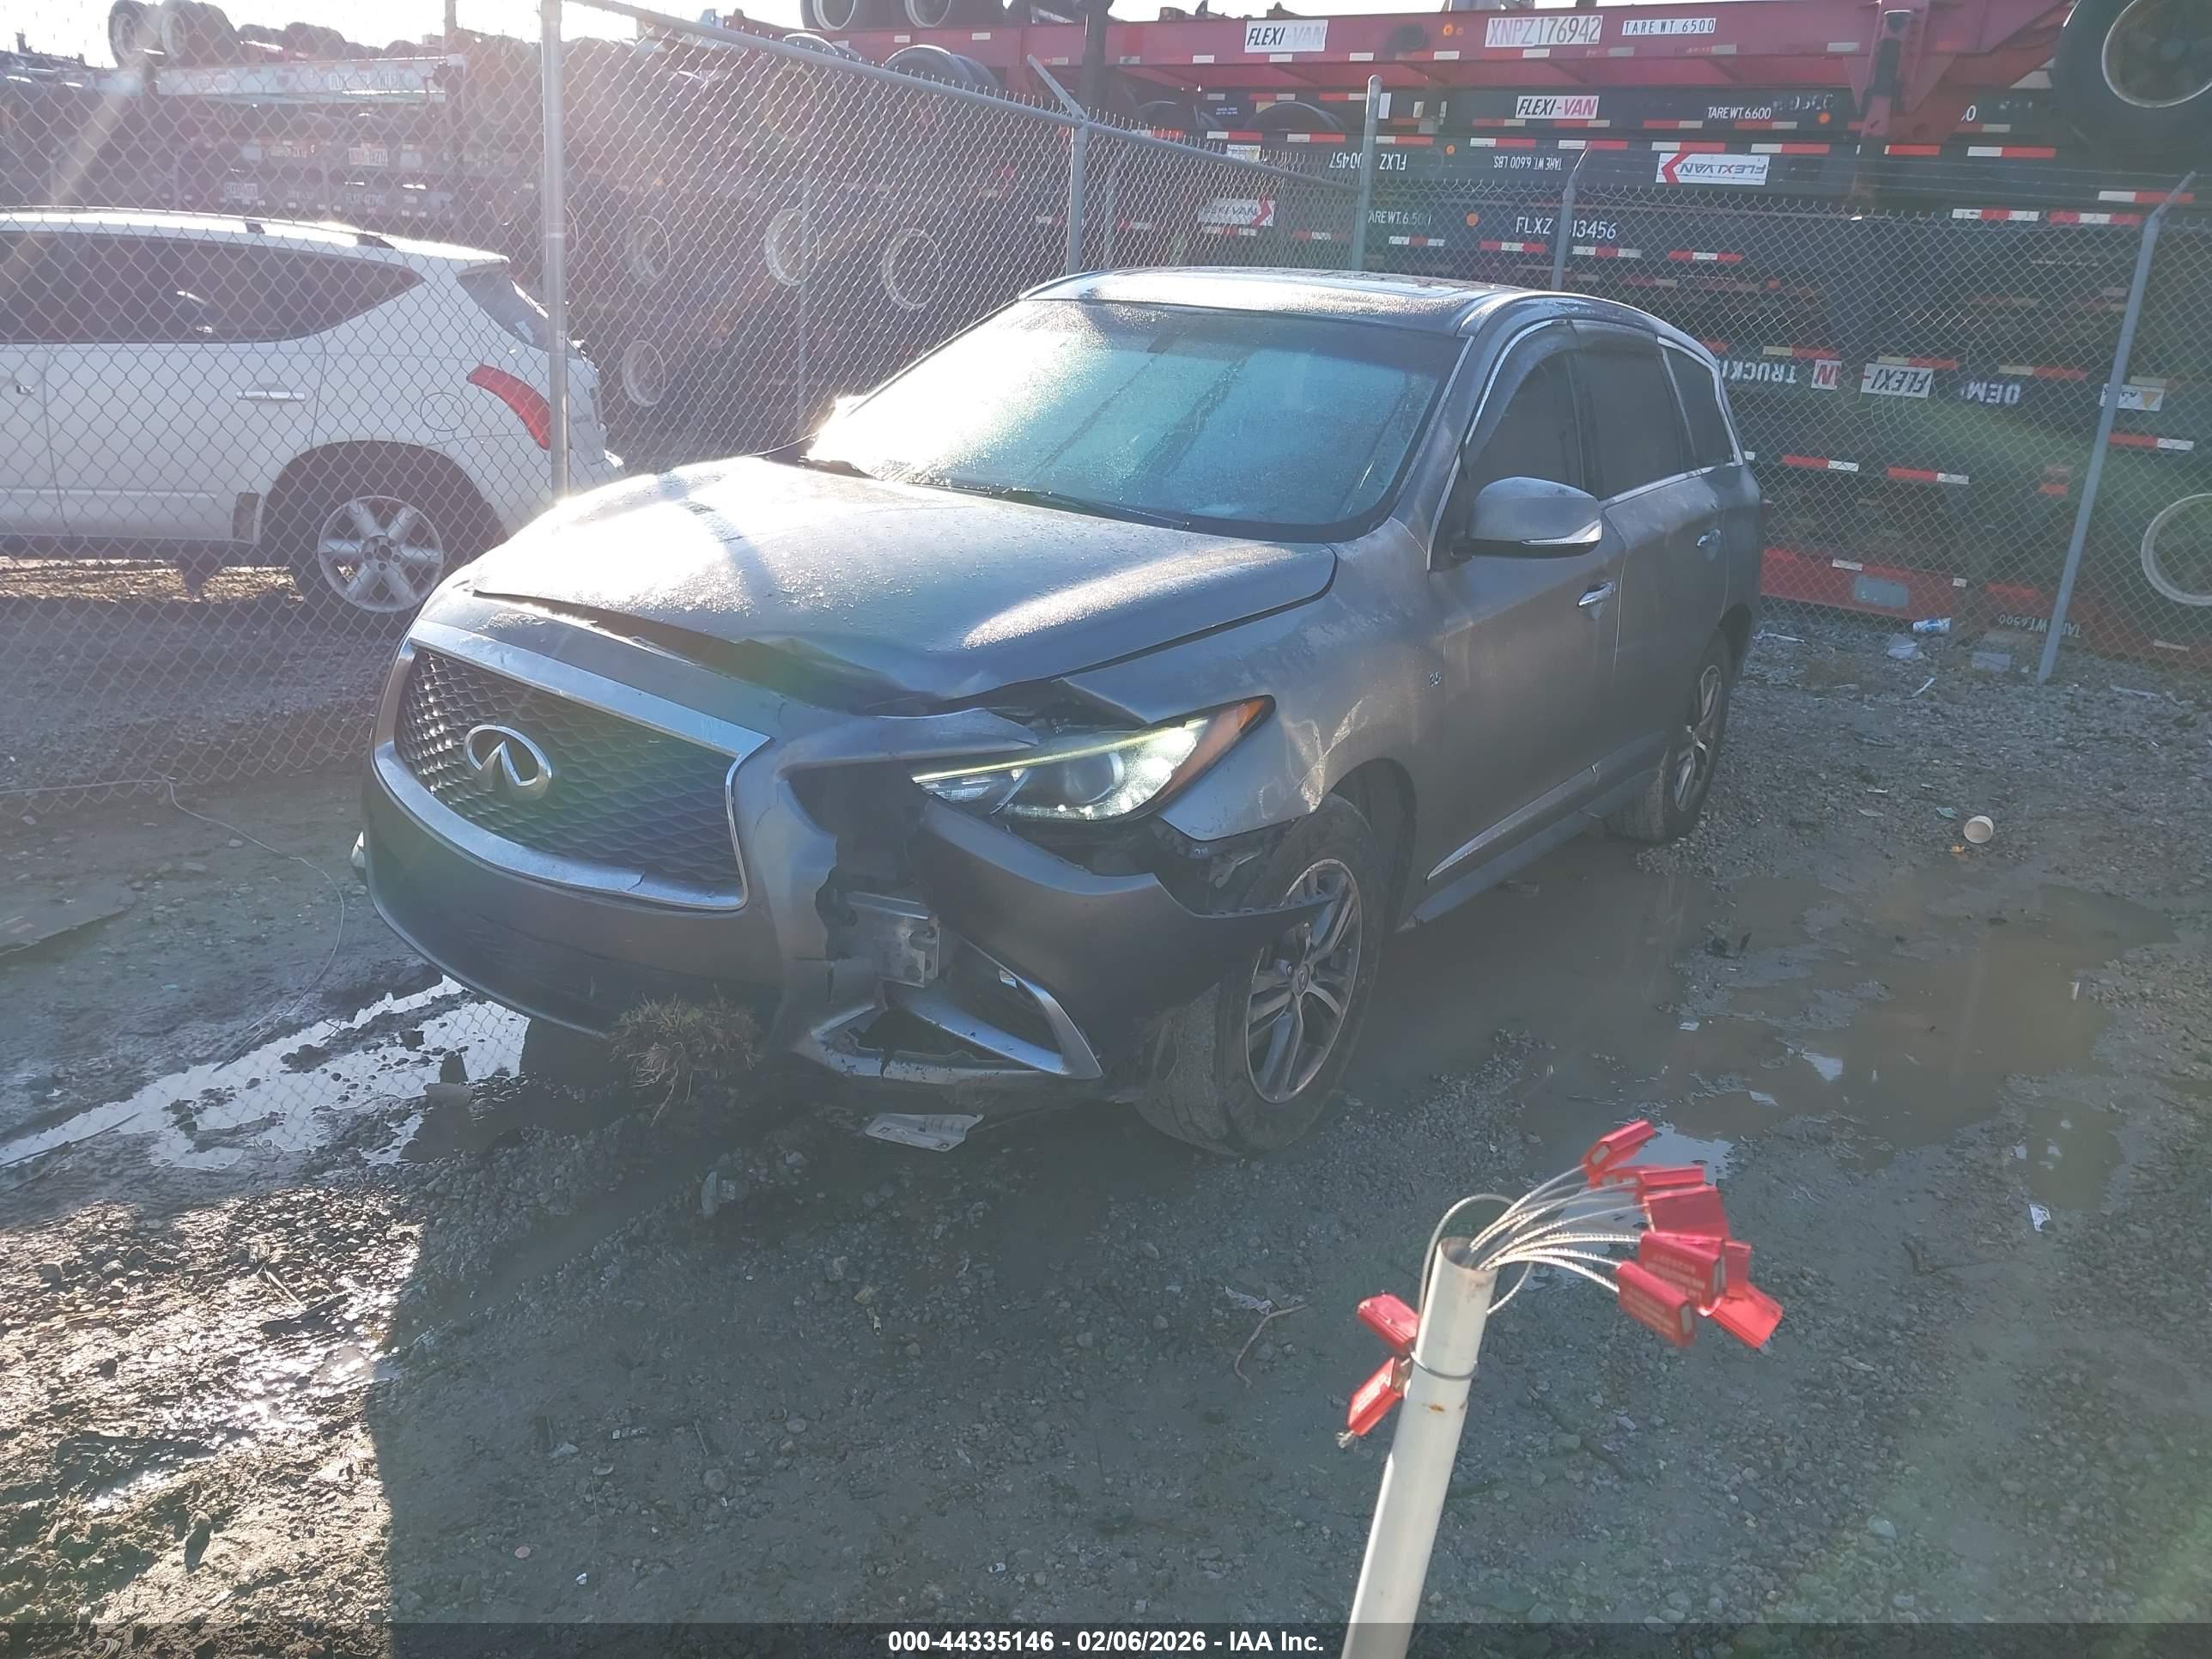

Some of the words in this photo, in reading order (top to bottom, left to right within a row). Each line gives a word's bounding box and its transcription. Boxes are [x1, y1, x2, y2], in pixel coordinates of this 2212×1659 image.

[1625, 21, 1655, 35] TARE
[1682, 19, 1715, 33] 6500
[1517, 98, 1597, 116] FLEXI-VAN
[1379, 154, 1407, 170] FLXZ
[1367, 210, 1388, 224] ARE
[1516, 216, 1553, 234] FLXZ
[1570, 220, 1617, 240] 13456
